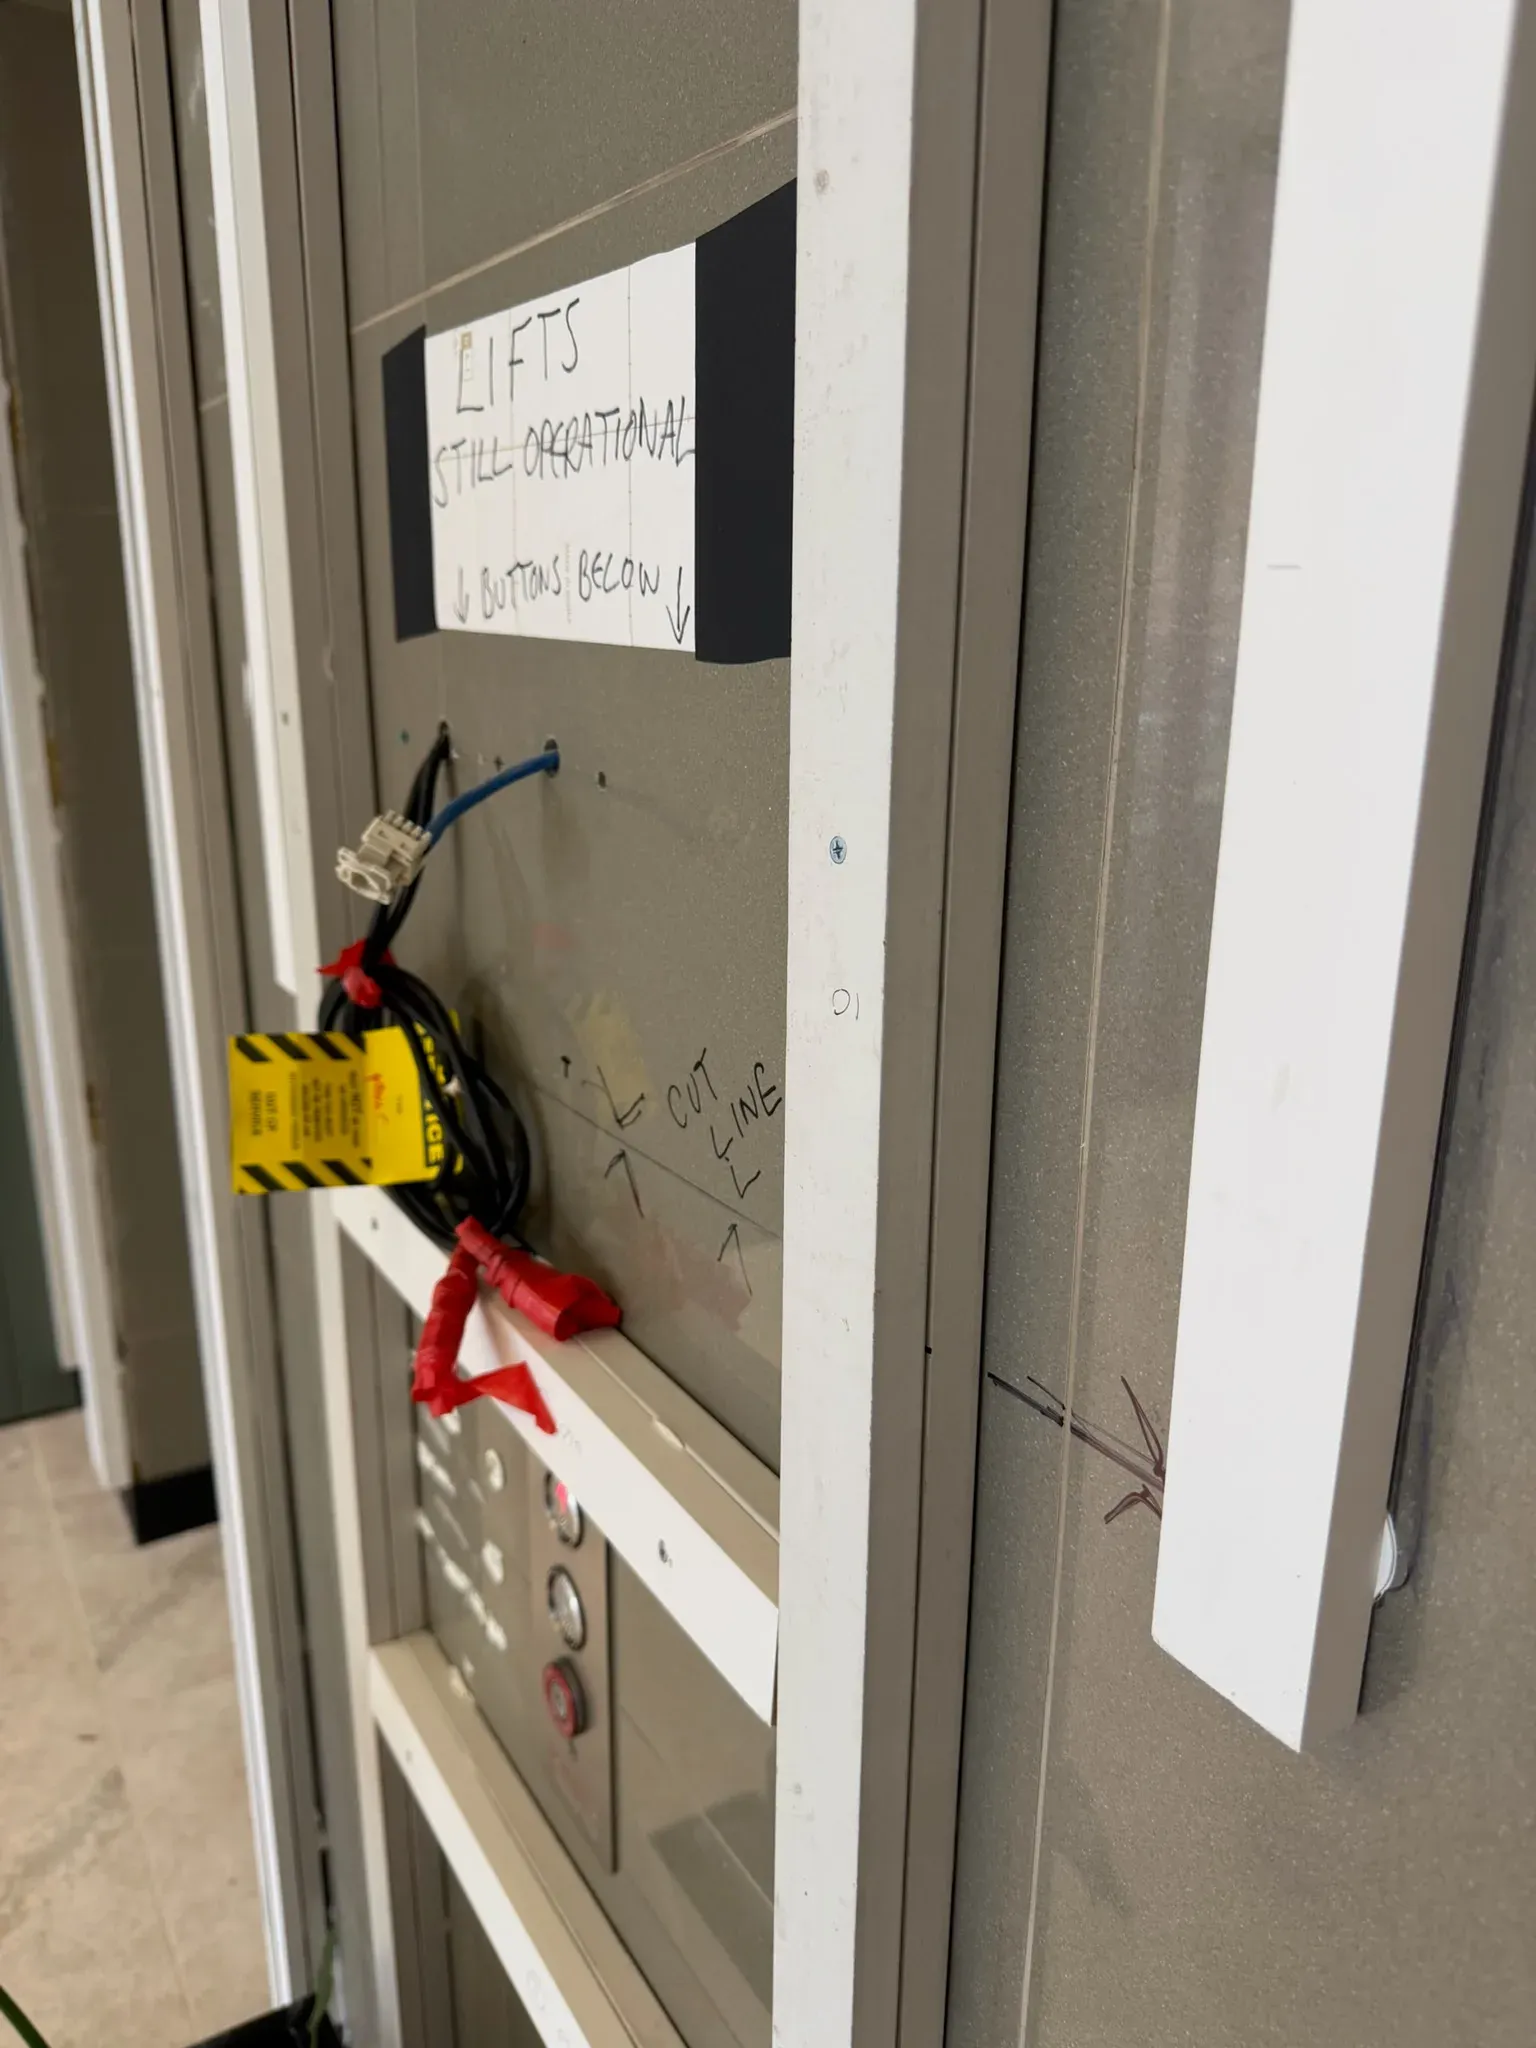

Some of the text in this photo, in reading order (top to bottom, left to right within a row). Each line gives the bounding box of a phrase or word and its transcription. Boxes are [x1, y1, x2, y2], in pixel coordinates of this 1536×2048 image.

[456, 298, 580, 414] LIFTS
[434, 395, 695, 509] STILL OPERATIONAL
[481, 555, 561, 620] BUTTONS
[578, 549, 660, 602] BELOW
[667, 1047, 718, 1129] CUT
[710, 1062, 783, 1160] LINE
